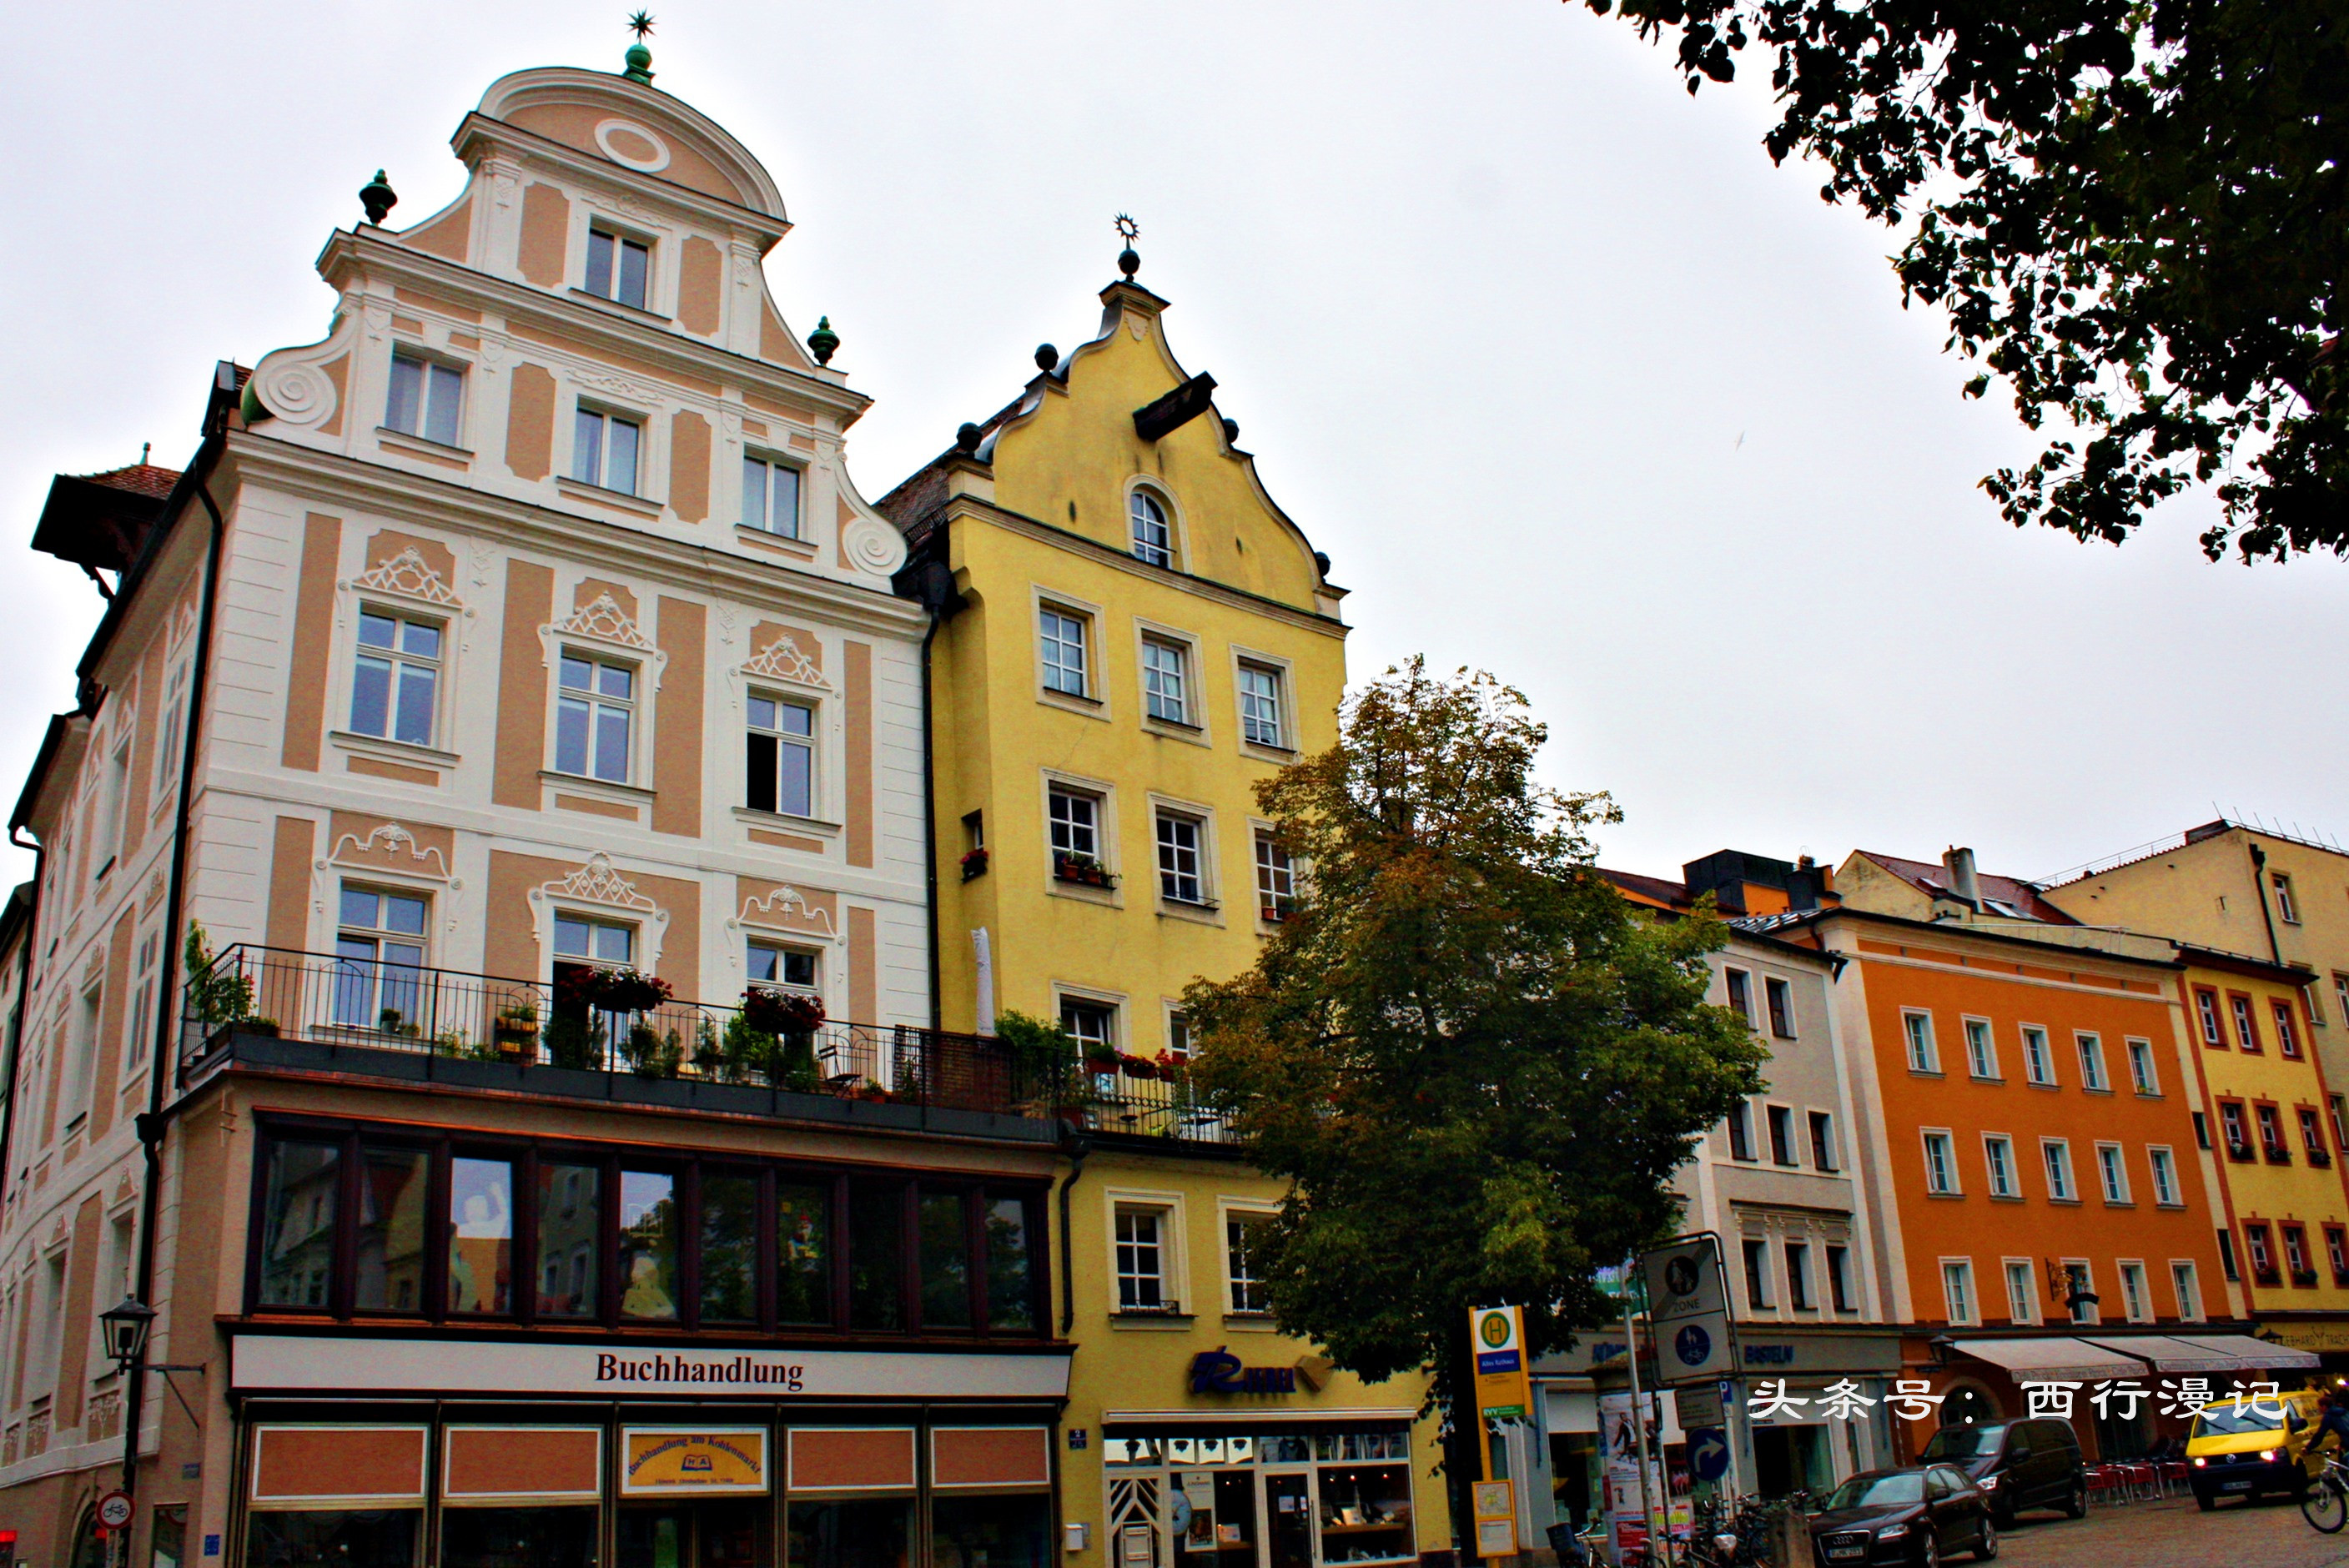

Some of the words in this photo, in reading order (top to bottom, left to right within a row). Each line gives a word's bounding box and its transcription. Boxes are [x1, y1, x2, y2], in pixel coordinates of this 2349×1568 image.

[1673, 1298, 1700, 1312] ZONE
[1490, 1319, 1502, 1340] H
[596, 1354, 803, 1391] Buchhandlung
[1481, 1360, 1494, 1369] Altes
[1074, 1429, 1081, 1437] 2
[629, 1436, 687, 1475] Buchhandlung
[691, 1436, 705, 1445] am
[708, 1436, 761, 1474] Kohlenmarkt
